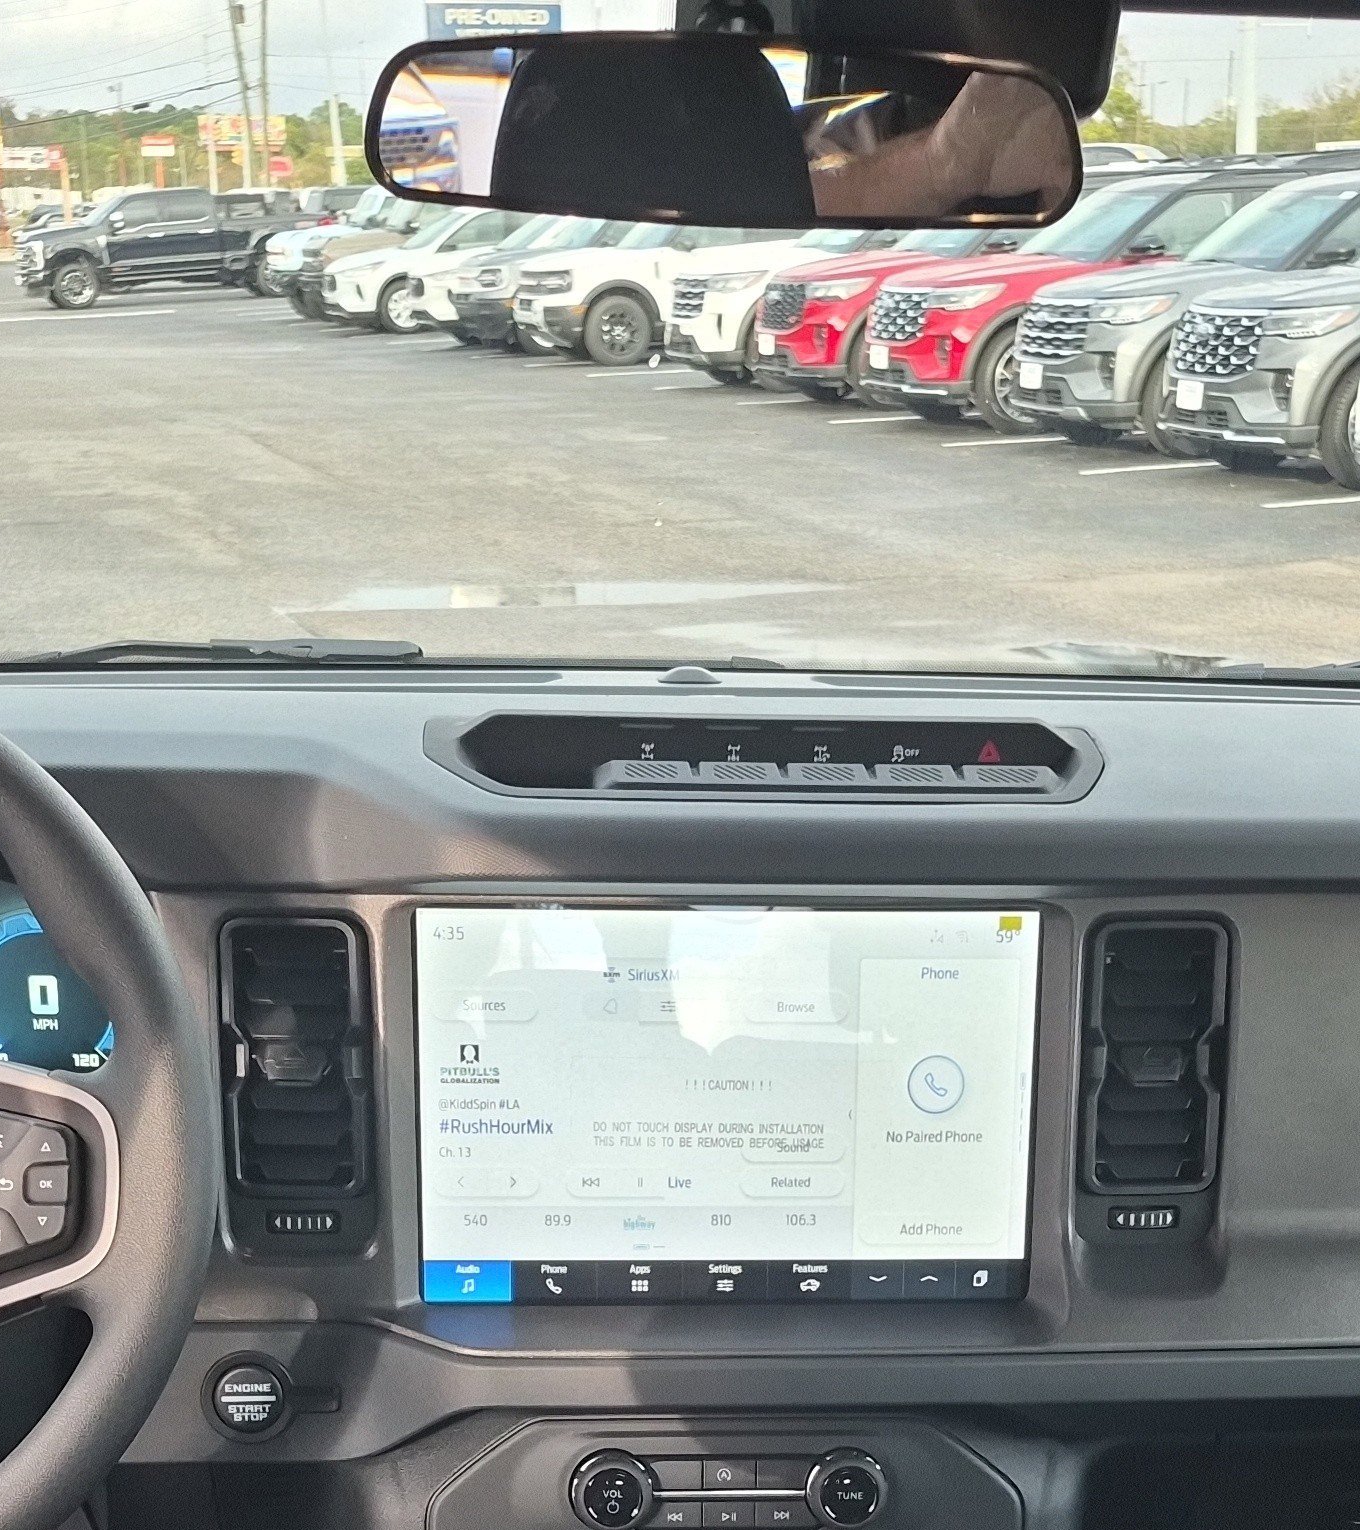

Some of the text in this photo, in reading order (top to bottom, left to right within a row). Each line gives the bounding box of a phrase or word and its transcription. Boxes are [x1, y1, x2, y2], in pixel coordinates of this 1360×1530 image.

[444, 8, 550, 25] PRE-OWNED
[904, 748, 920, 757] OFF
[432, 926, 465, 940] 4:35
[628, 968, 680, 982] SiriusXM
[921, 967, 960, 980] Phone
[28, 974, 60, 1015] 0
[462, 1000, 506, 1012] Sources
[776, 1001, 816, 1013] Browse
[32, 1018, 59, 1031] MPH
[72, 1053, 100, 1068] 120
[439, 1098, 520, 1112] @KiddSpin #LA
[440, 1118, 554, 1135] #RushHourMix
[593, 1122, 824, 1134] DO NOT TOUCH DISPLAY DURING INSTALLATION
[594, 1136, 824, 1149] THIS FILM IS TO BE REMOVED BEFORE USAGE
[886, 1130, 983, 1144] No Paired Phone
[439, 1146, 471, 1158] Ch. 13
[776, 1141, 810, 1154] Sound
[39, 1180, 53, 1189] OK
[668, 1176, 692, 1188] Live
[771, 1177, 811, 1188] Related
[464, 1214, 488, 1226] 540
[544, 1214, 572, 1226] 89.9
[710, 1214, 732, 1226] 810
[786, 1214, 816, 1226] 106.3
[900, 1224, 963, 1236] Add Phone
[456, 1264, 480, 1274] Audio
[540, 1264, 568, 1274] Phone
[630, 1264, 651, 1276] Apps
[708, 1264, 742, 1276] Settings
[792, 1264, 828, 1274] Features
[224, 1383, 272, 1393] ENGINE
[228, 1404, 272, 1414] START
[233, 1412, 268, 1422] STOP
[602, 1490, 624, 1498] VOL
[837, 1492, 864, 1500] TUNE
